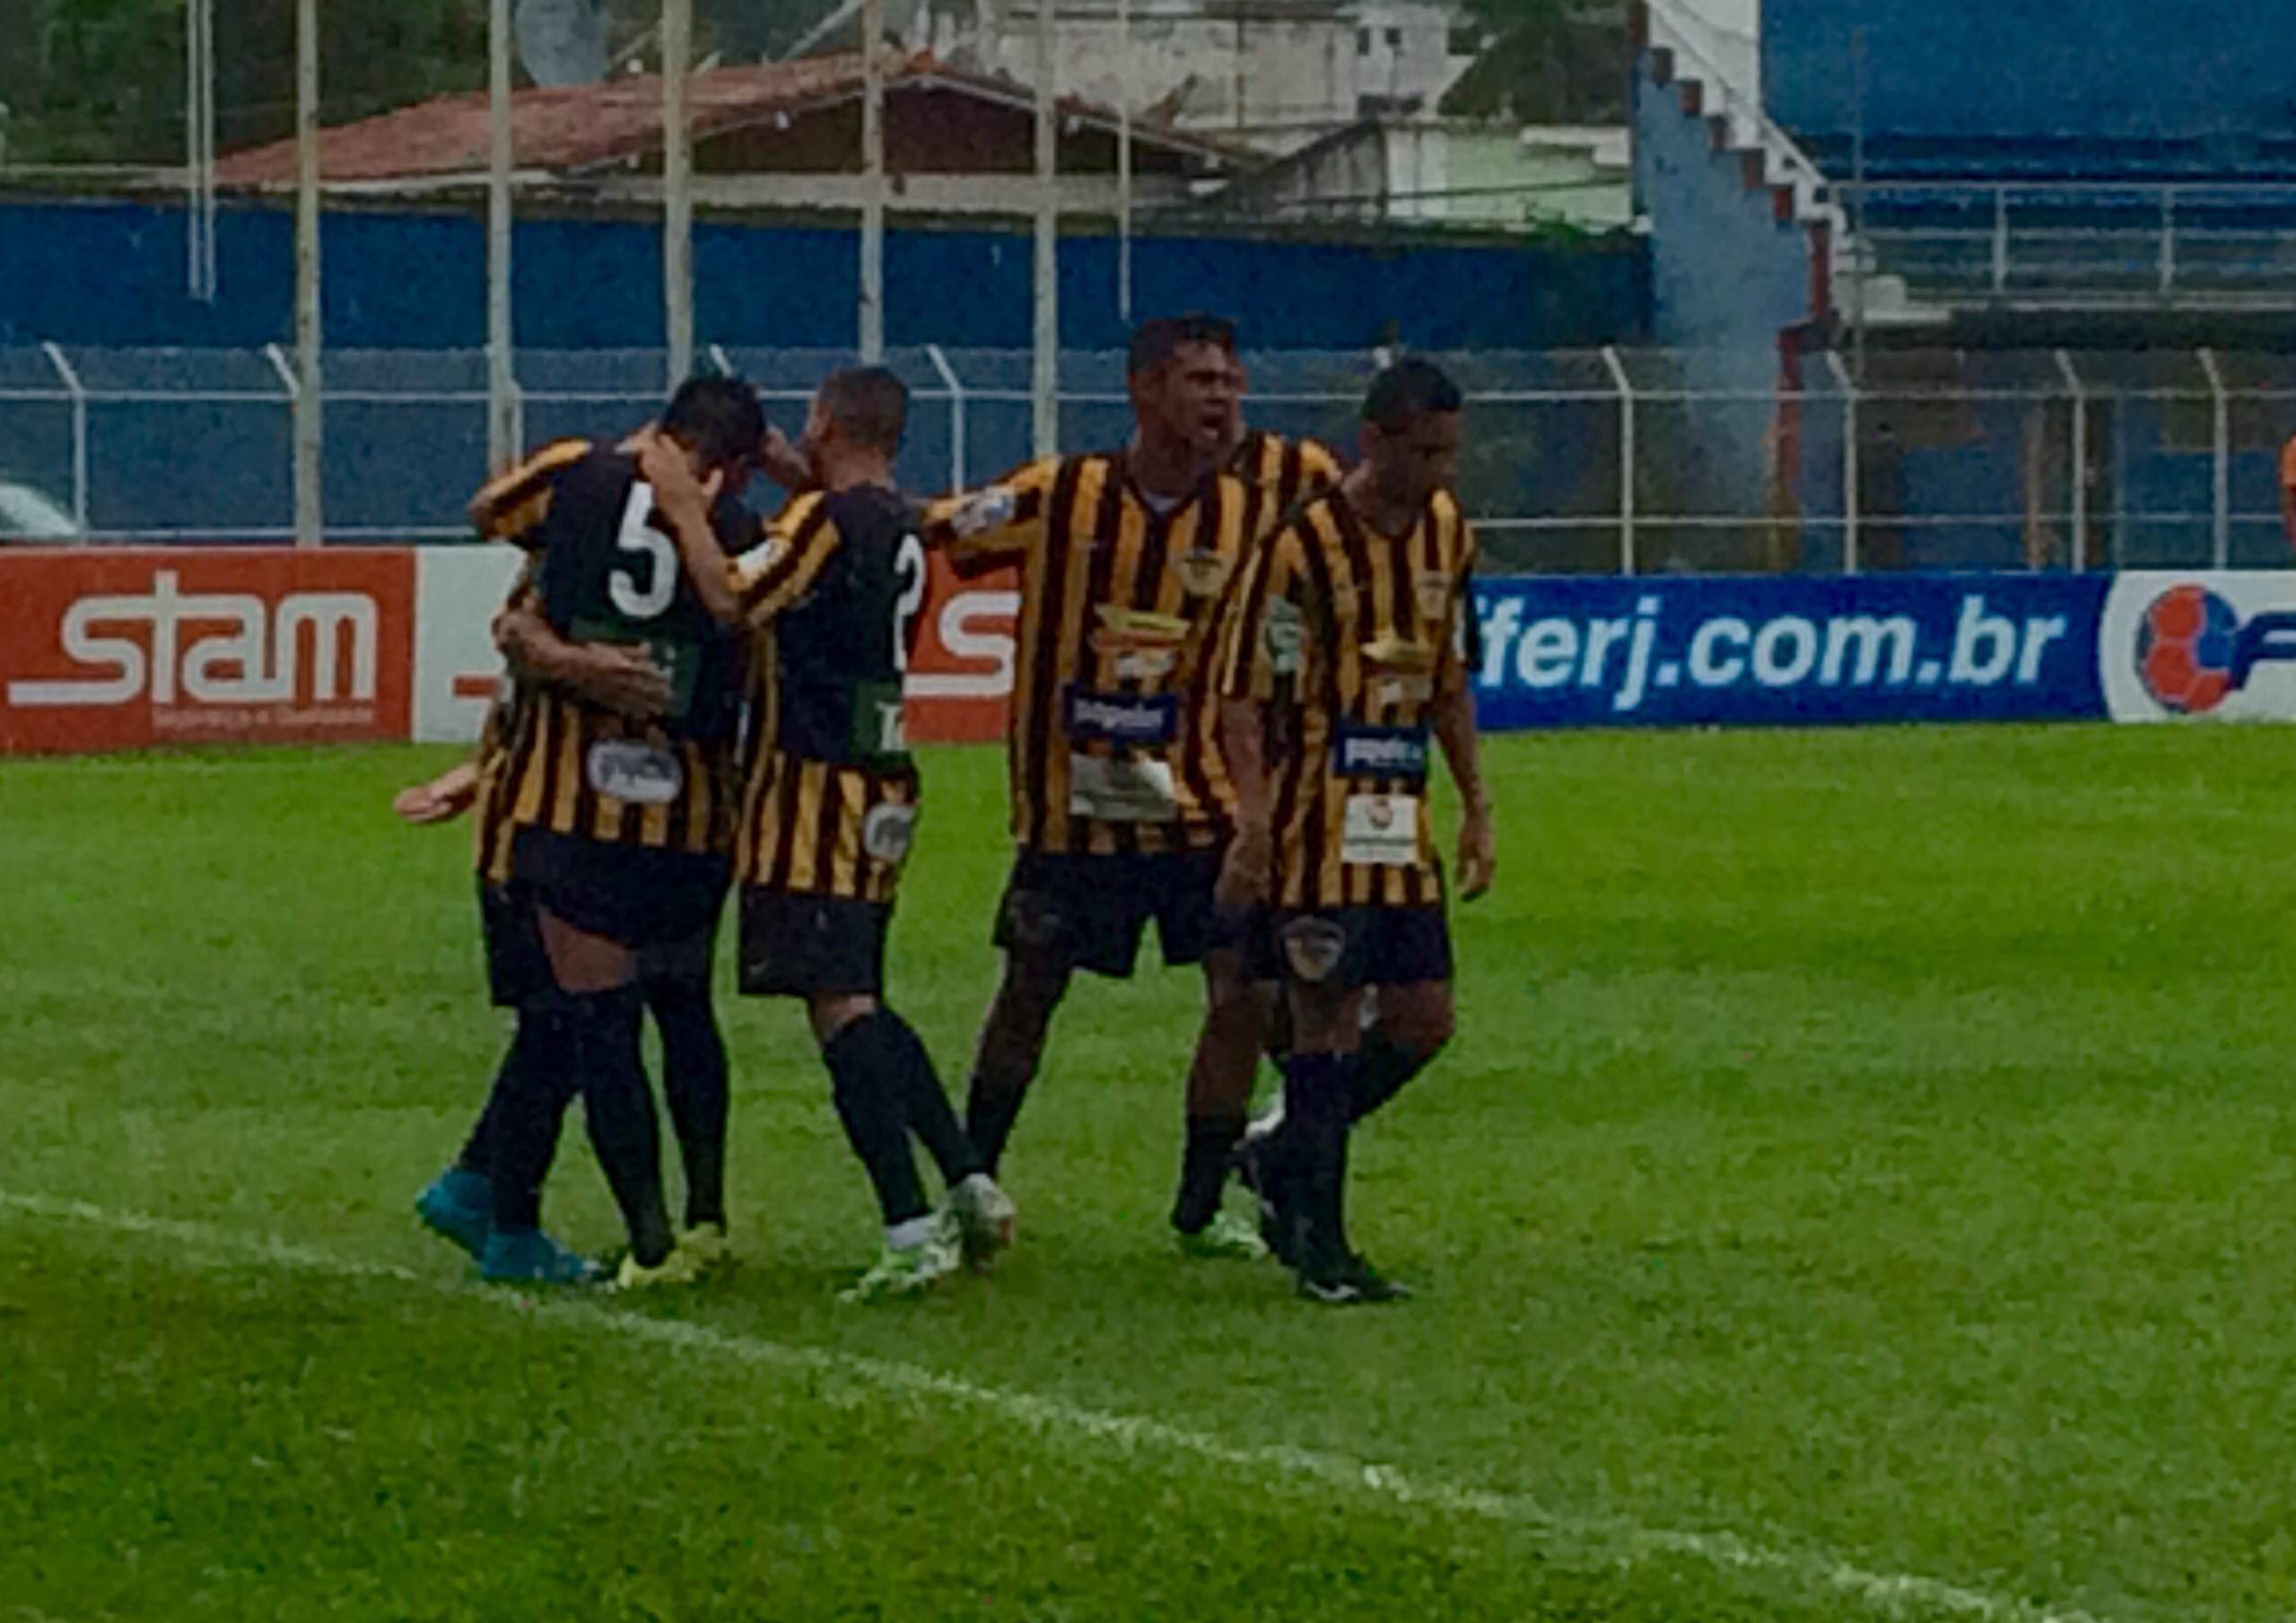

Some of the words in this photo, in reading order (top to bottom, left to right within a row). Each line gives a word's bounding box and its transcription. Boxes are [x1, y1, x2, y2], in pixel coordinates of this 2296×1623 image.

[610, 482, 678, 618] 5
[7, 570, 377, 704] stam
[1476, 595, 2065, 711] ferj.com.br
